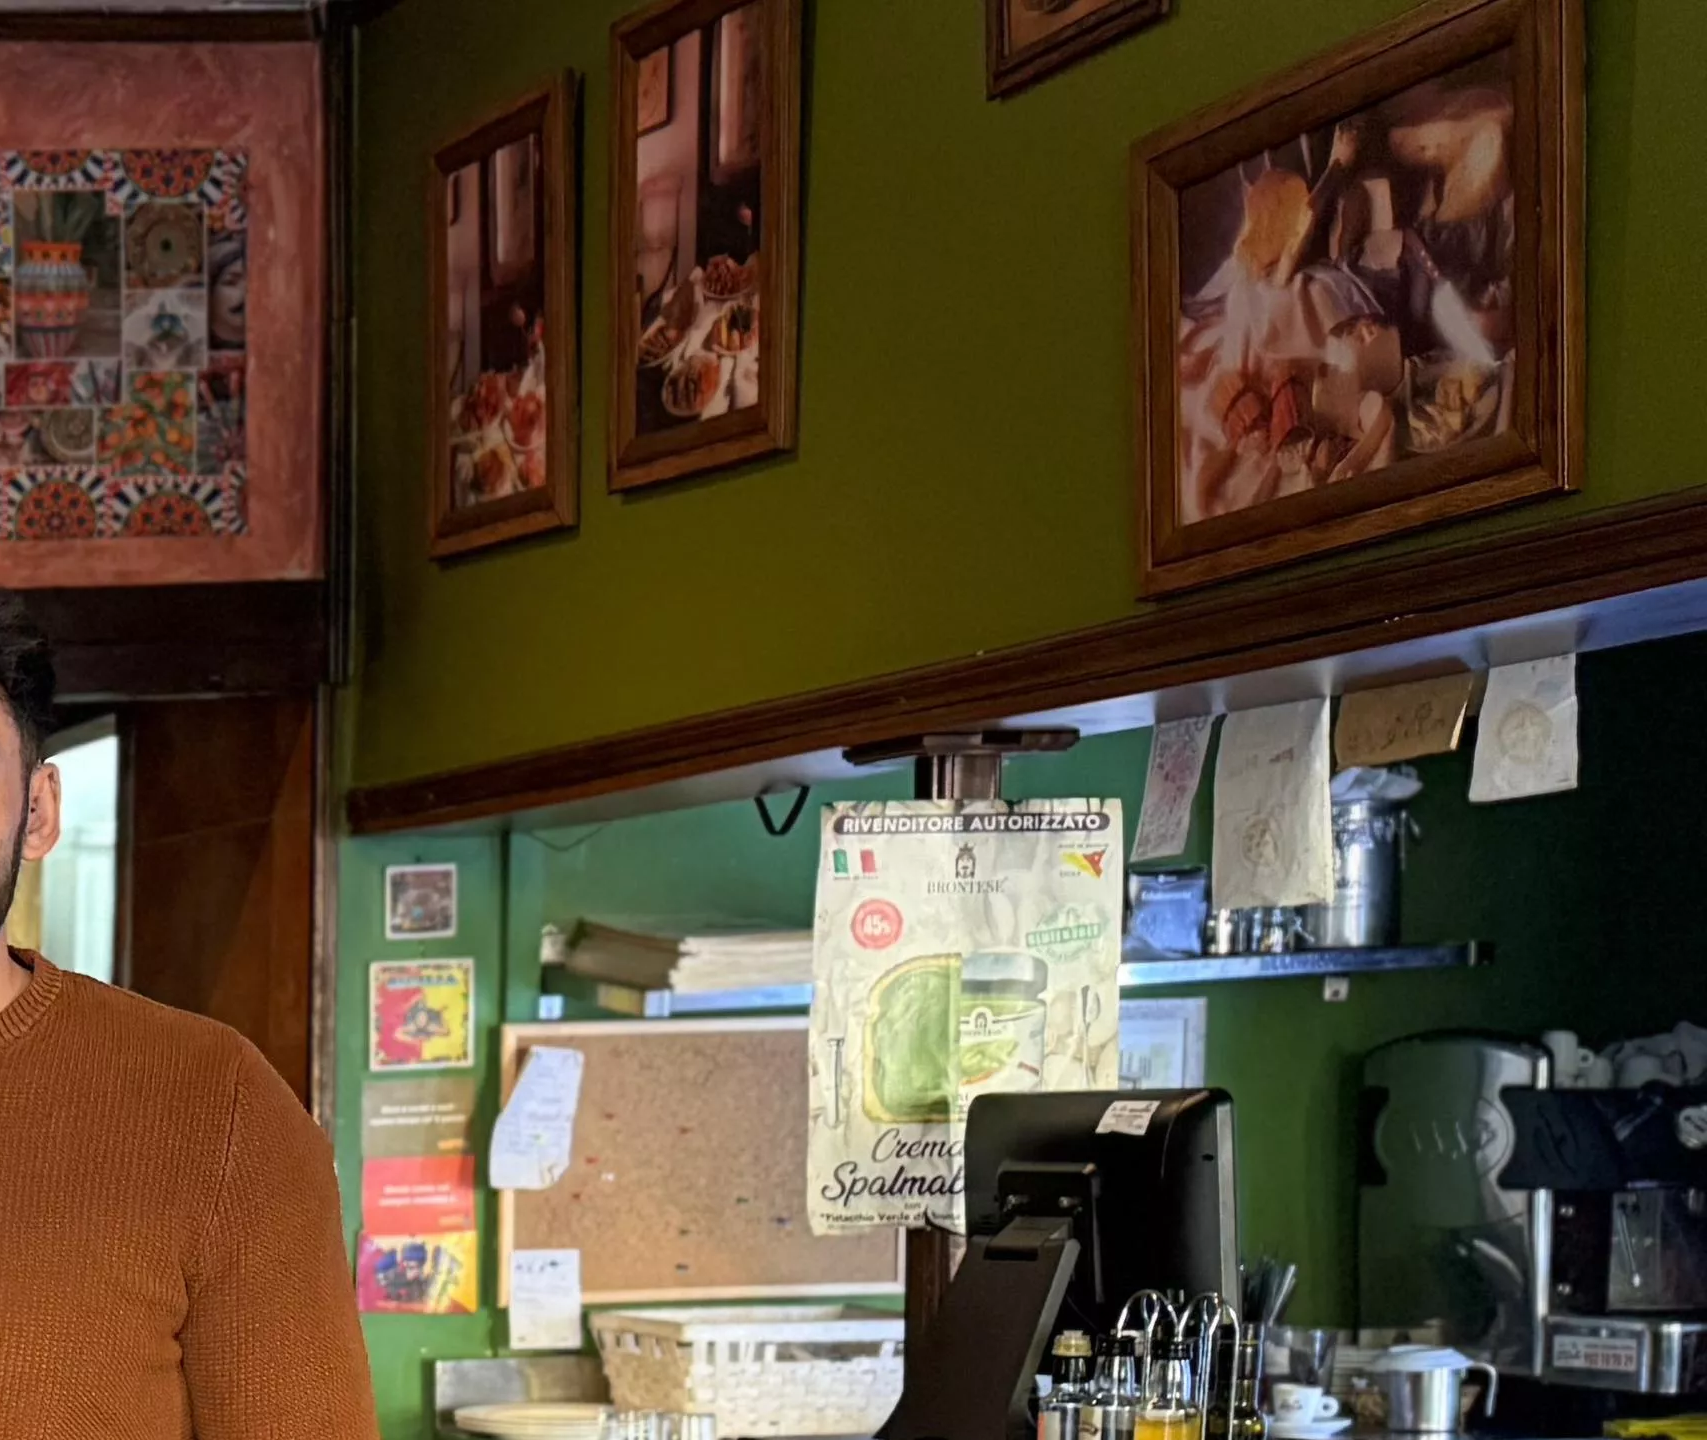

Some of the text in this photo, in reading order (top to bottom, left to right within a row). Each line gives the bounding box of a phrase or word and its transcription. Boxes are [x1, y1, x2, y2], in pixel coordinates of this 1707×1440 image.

[843, 814, 1101, 832] RIVENDITORE AUTORIZZATO
[927, 879, 1003, 894] BRONTESE
